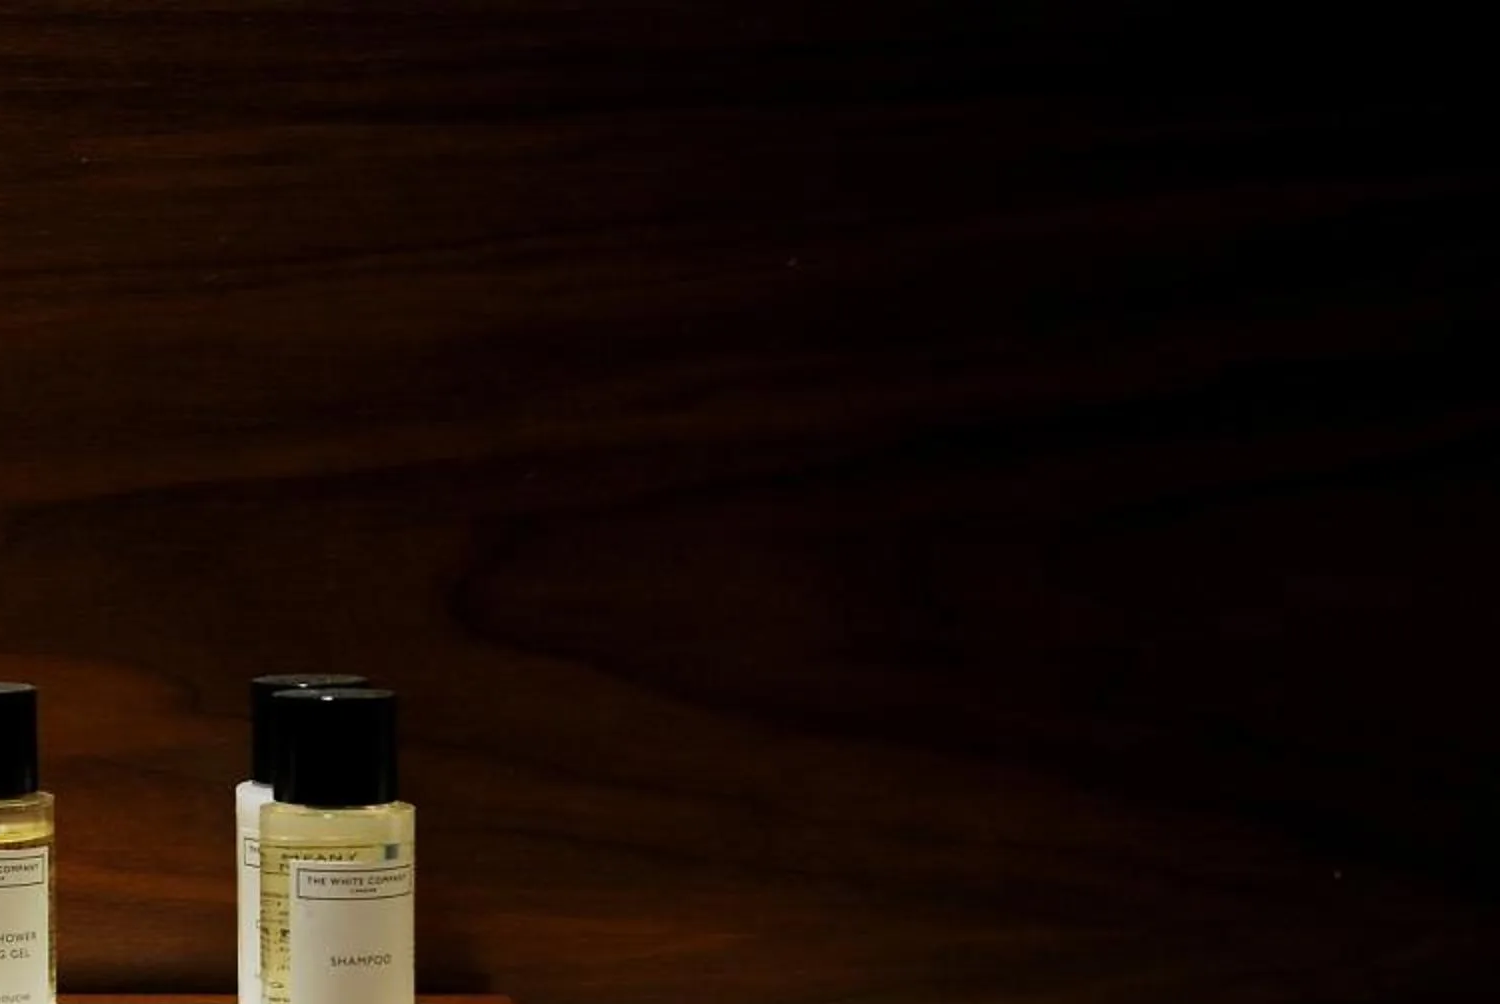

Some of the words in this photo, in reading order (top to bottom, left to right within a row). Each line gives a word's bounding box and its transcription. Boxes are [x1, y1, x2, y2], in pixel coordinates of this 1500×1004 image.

[307, 875, 326, 886] THE
[330, 876, 365, 887] WHITE
[9, 947, 31, 960] GEL
[329, 952, 393, 968] SHAMPOO
